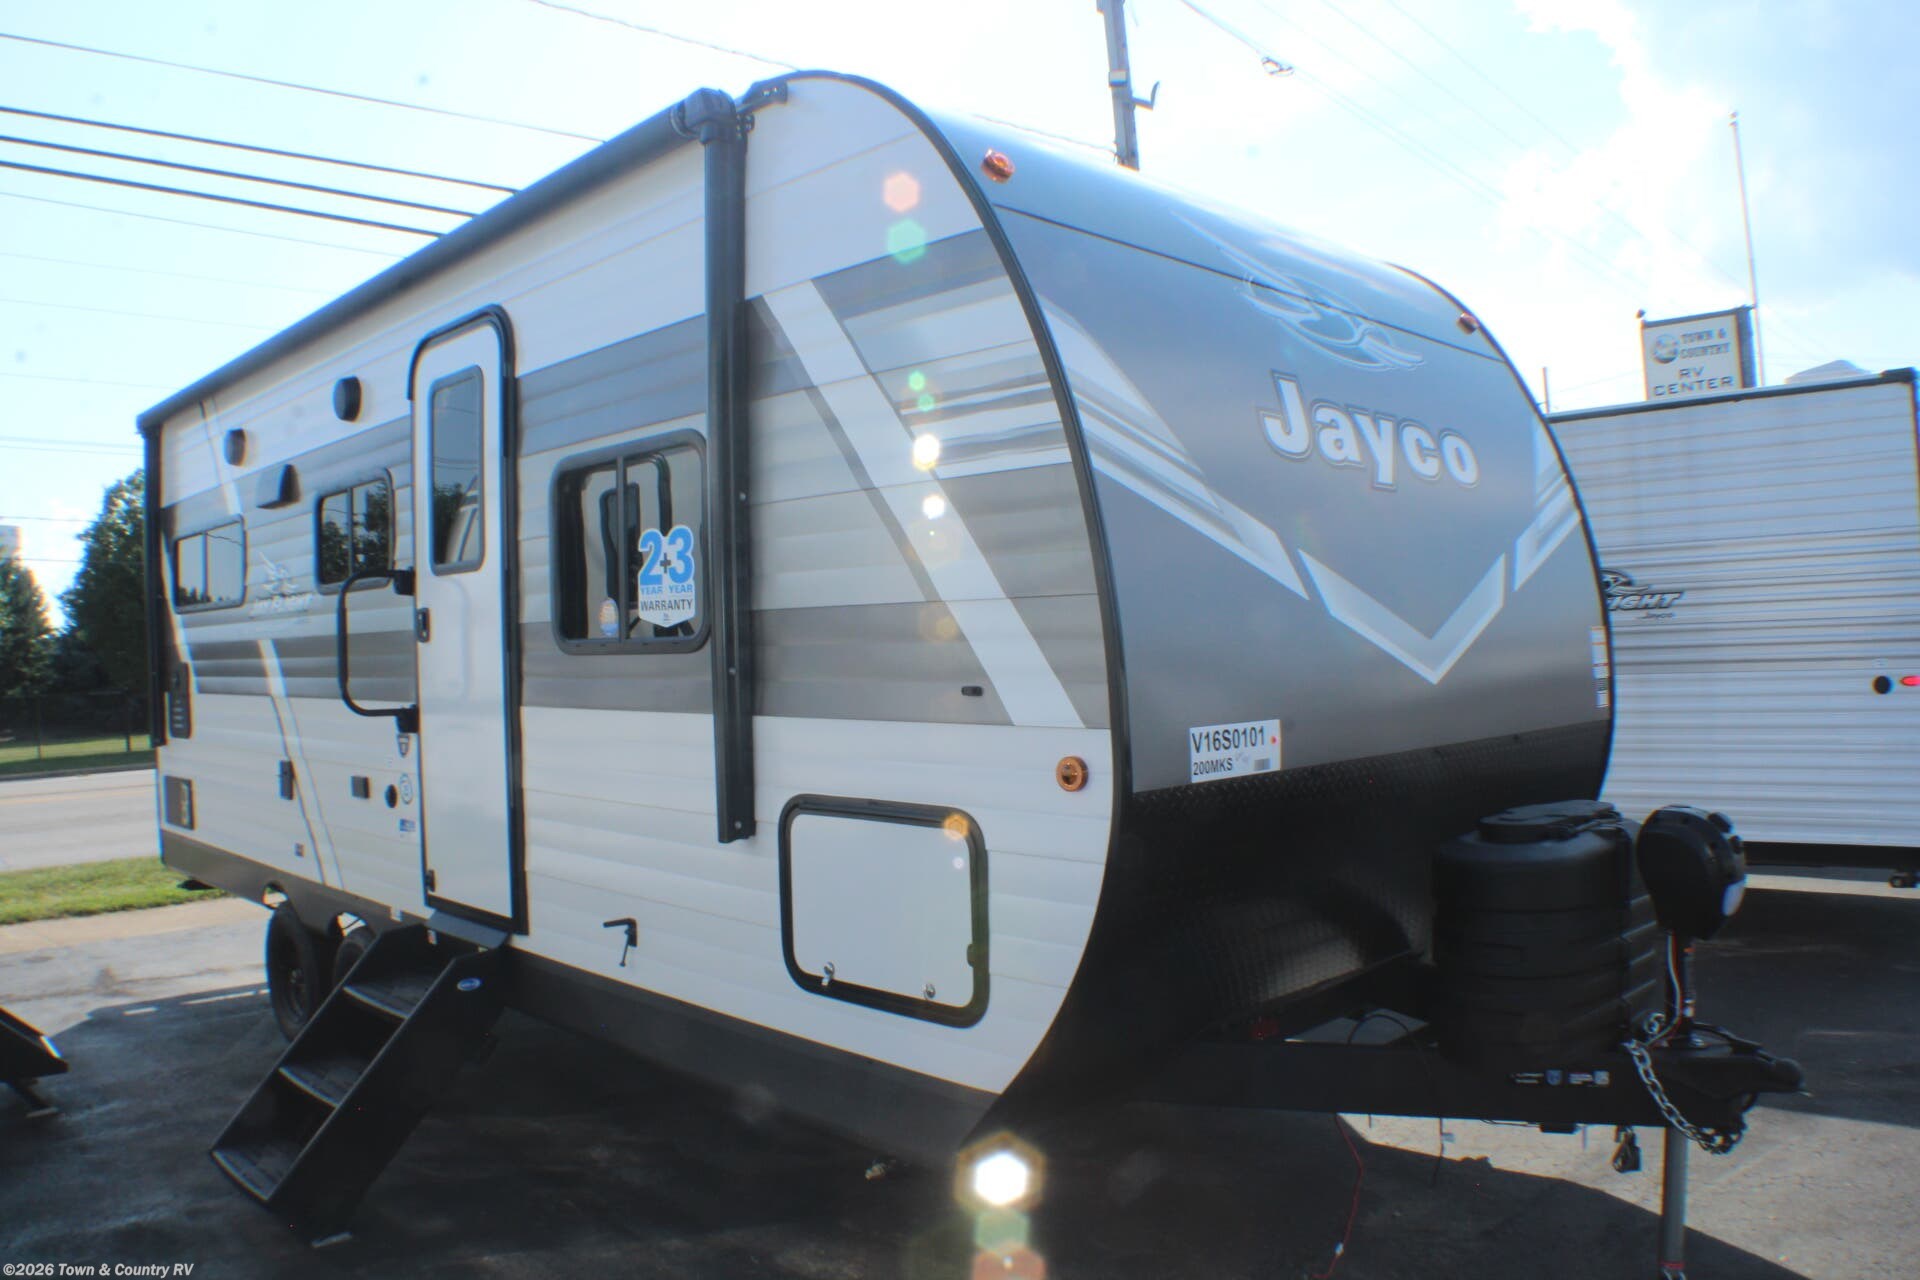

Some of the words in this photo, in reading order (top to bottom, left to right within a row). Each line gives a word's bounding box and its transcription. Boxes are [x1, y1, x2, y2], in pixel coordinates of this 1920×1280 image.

[1679, 366, 1705, 379] RV
[1653, 376, 1734, 397] CENTER
[1257, 370, 1481, 490] Jayco
[640, 585, 663, 596] YEAR
[668, 583, 694, 594] YEAR
[640, 598, 694, 611] WARRANTY
[1606, 591, 1683, 611] IGHT
[1191, 725, 1265, 754] V16S0101
[1193, 757, 1233, 776] 200MKS
